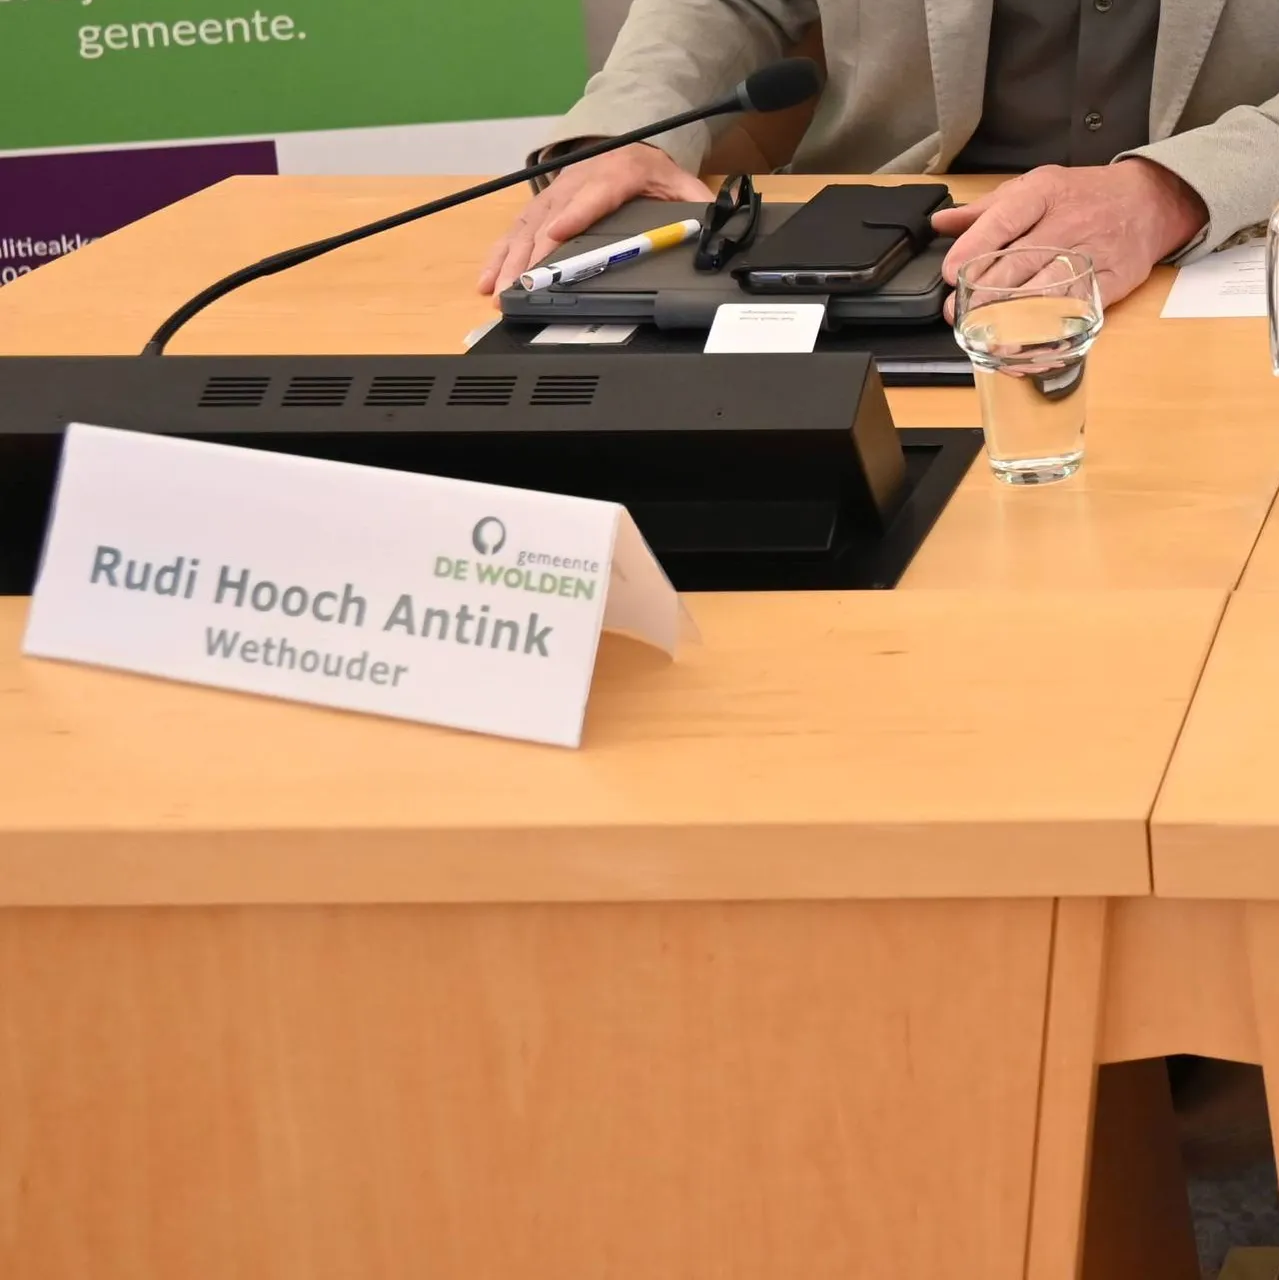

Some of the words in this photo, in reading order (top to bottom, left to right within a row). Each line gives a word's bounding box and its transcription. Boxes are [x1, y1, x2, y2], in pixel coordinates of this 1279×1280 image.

[78, 9, 307, 59] gemeente.
[433, 556, 468, 581] DE
[476, 562, 597, 601] WOLDEN
[517, 549, 599, 573] gemeente
[89, 545, 200, 600] Rudi
[213, 565, 368, 627] Hooch
[383, 593, 555, 658] Antink
[205, 626, 408, 688] Wethouder
